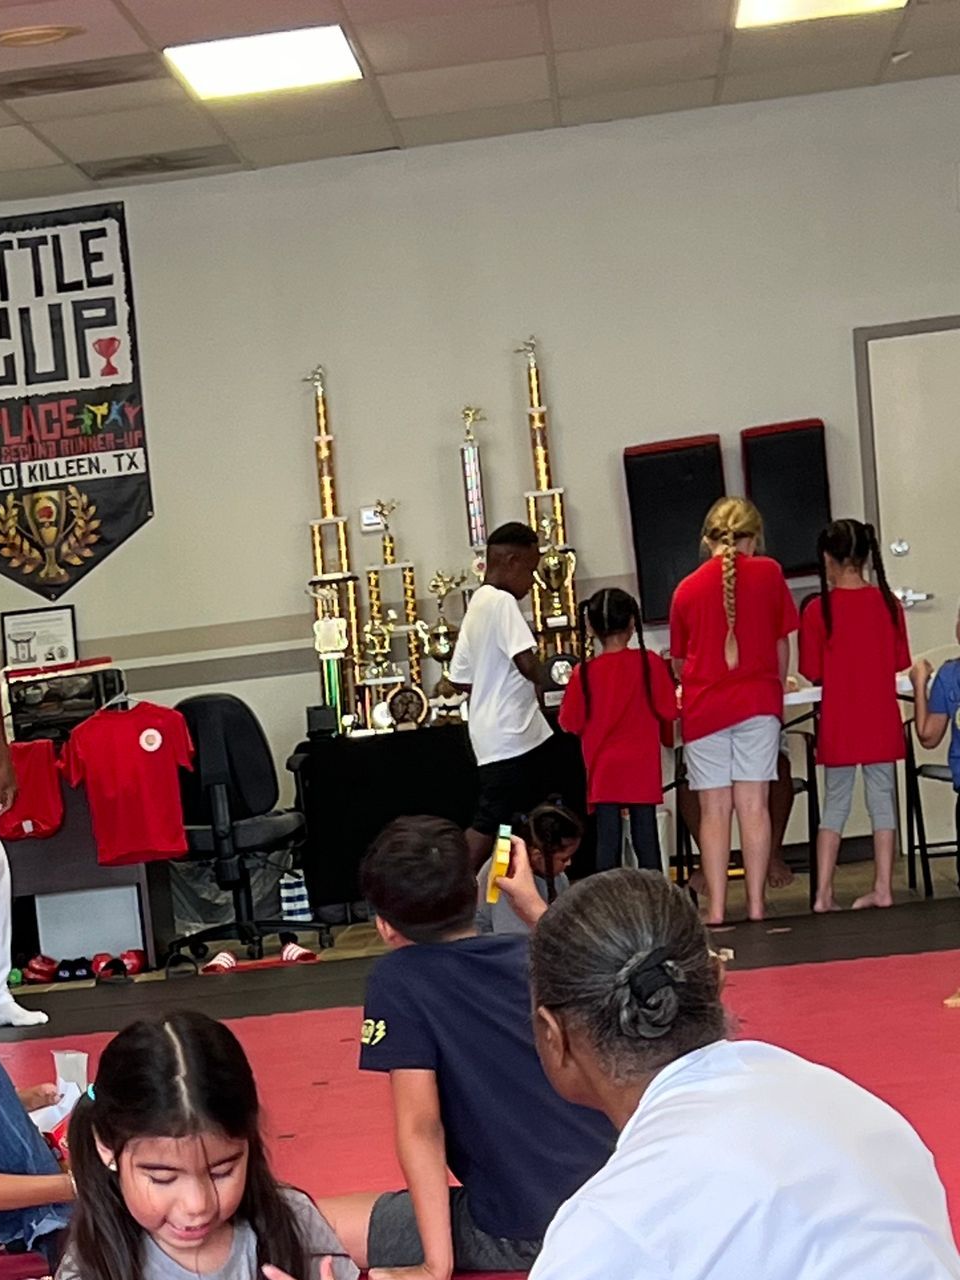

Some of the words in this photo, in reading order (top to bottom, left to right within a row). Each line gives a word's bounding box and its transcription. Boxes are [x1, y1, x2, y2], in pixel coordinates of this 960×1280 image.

[1, 440, 57, 463] SECOND
[61, 430, 143, 456] RUNNER-UP
[113, 452, 139, 473] TX
